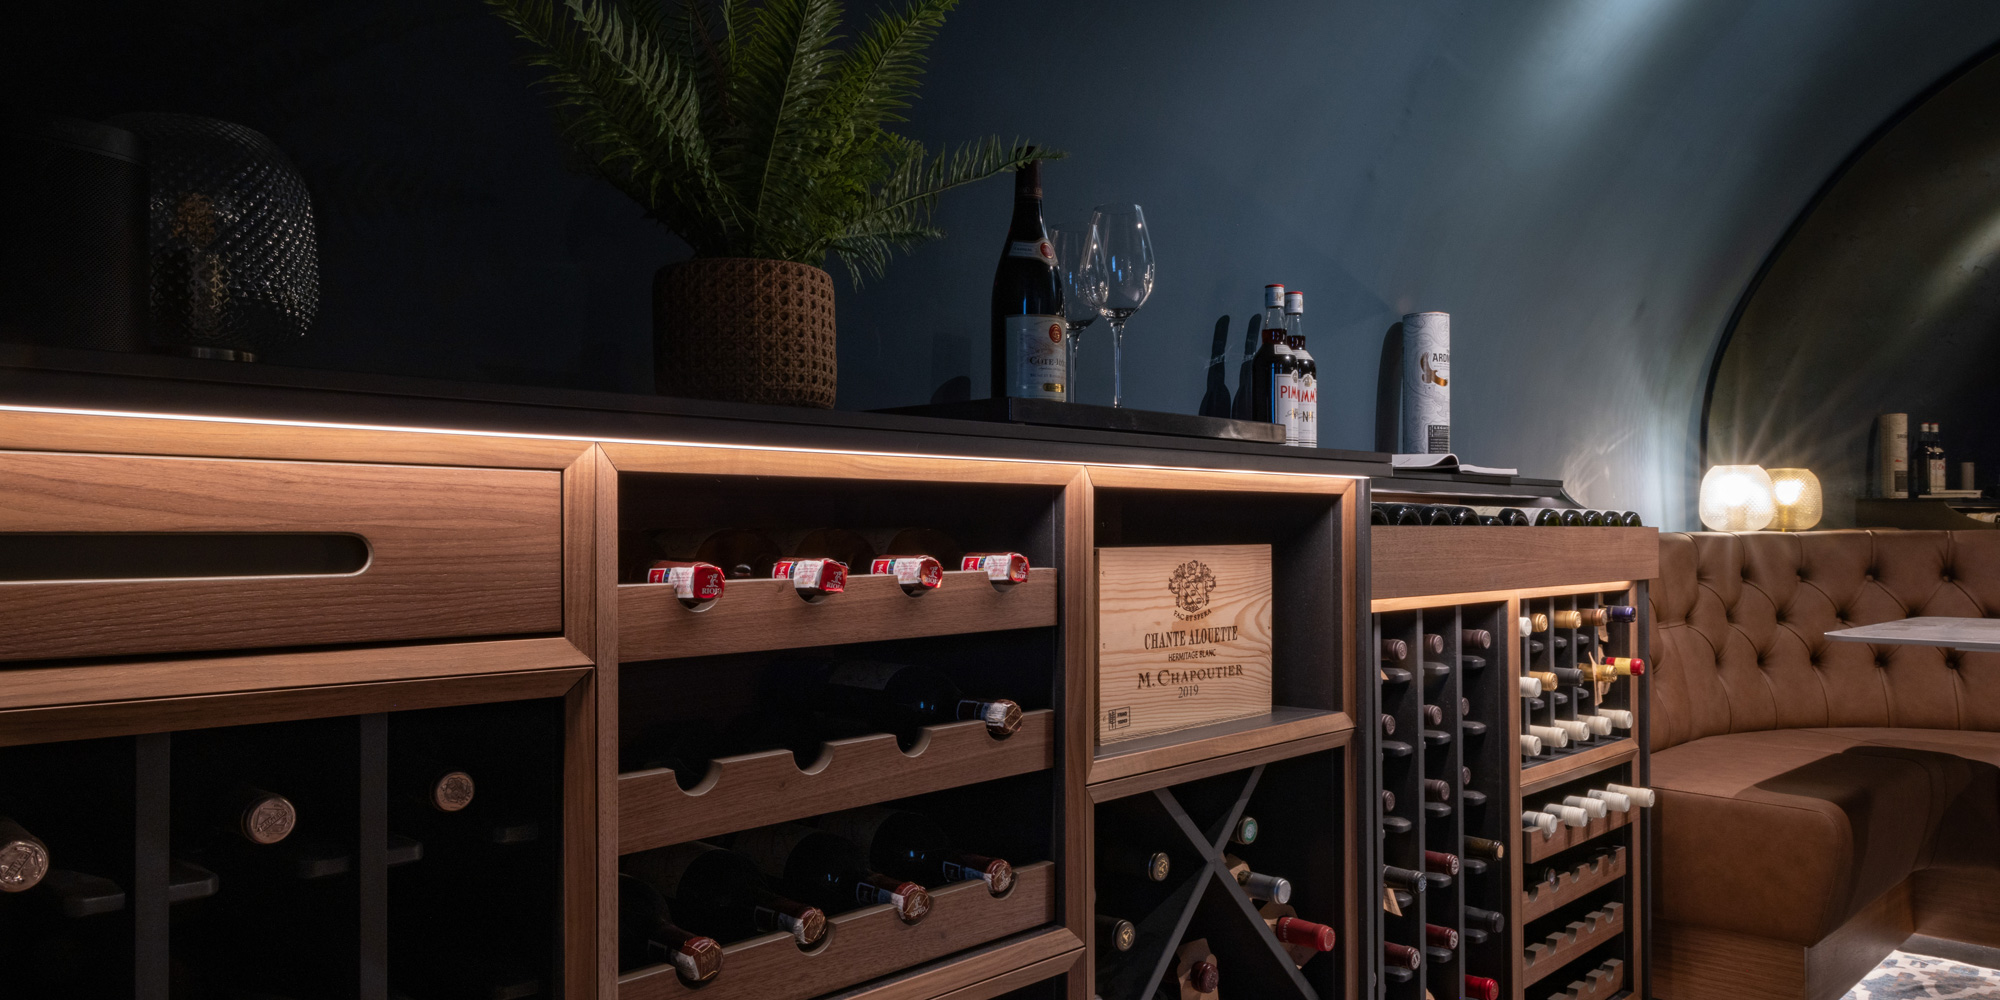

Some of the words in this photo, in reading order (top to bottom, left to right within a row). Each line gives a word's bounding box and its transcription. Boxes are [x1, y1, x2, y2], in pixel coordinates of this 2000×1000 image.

[1144, 630, 1186, 650] CHANTE
[1188, 625, 1238, 646] ALOUETTE
[1168, 650, 1199, 662] HERMITAGE
[1199, 648, 1217, 659] BLANC
[1137, 672, 1156, 690] M.
[1157, 664, 1244, 685] CHAPOUTIER
[1177, 684, 1199, 699] 2019
